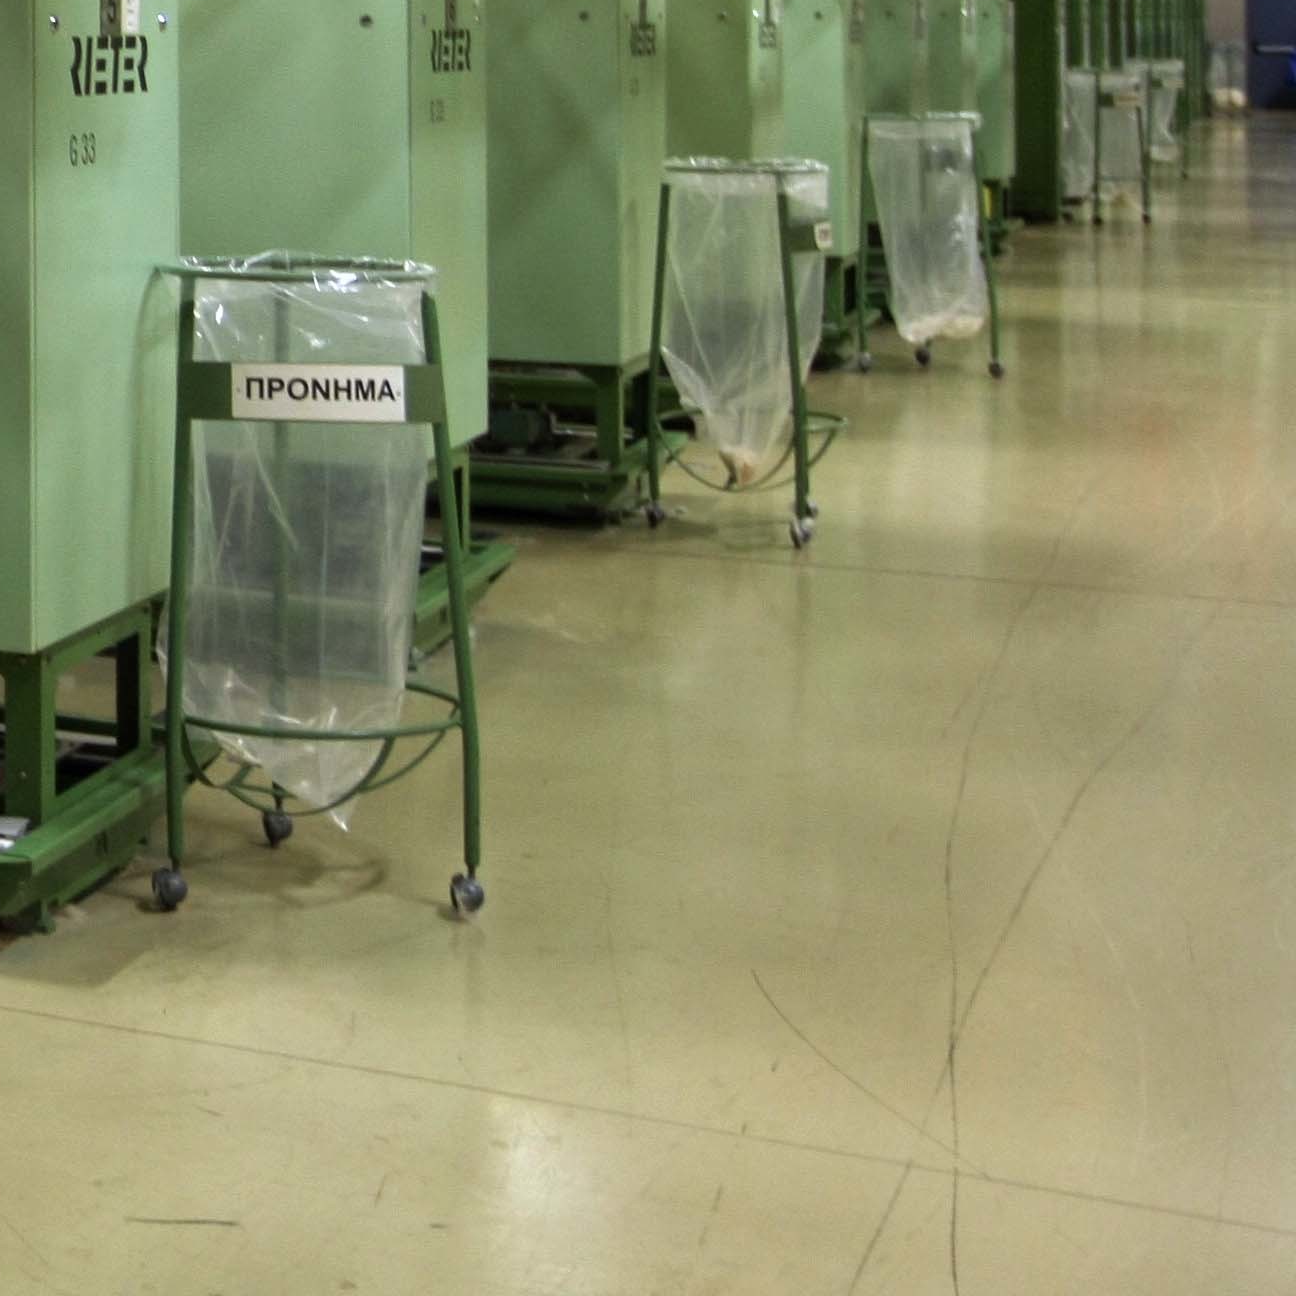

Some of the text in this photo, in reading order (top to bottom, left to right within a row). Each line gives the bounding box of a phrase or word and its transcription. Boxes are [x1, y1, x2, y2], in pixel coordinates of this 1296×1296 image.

[70, 36, 148, 96] RIETER
[69, 132, 96, 166] G 33
[244, 377, 396, 402] ΠΡΟΝΗΜΑ
